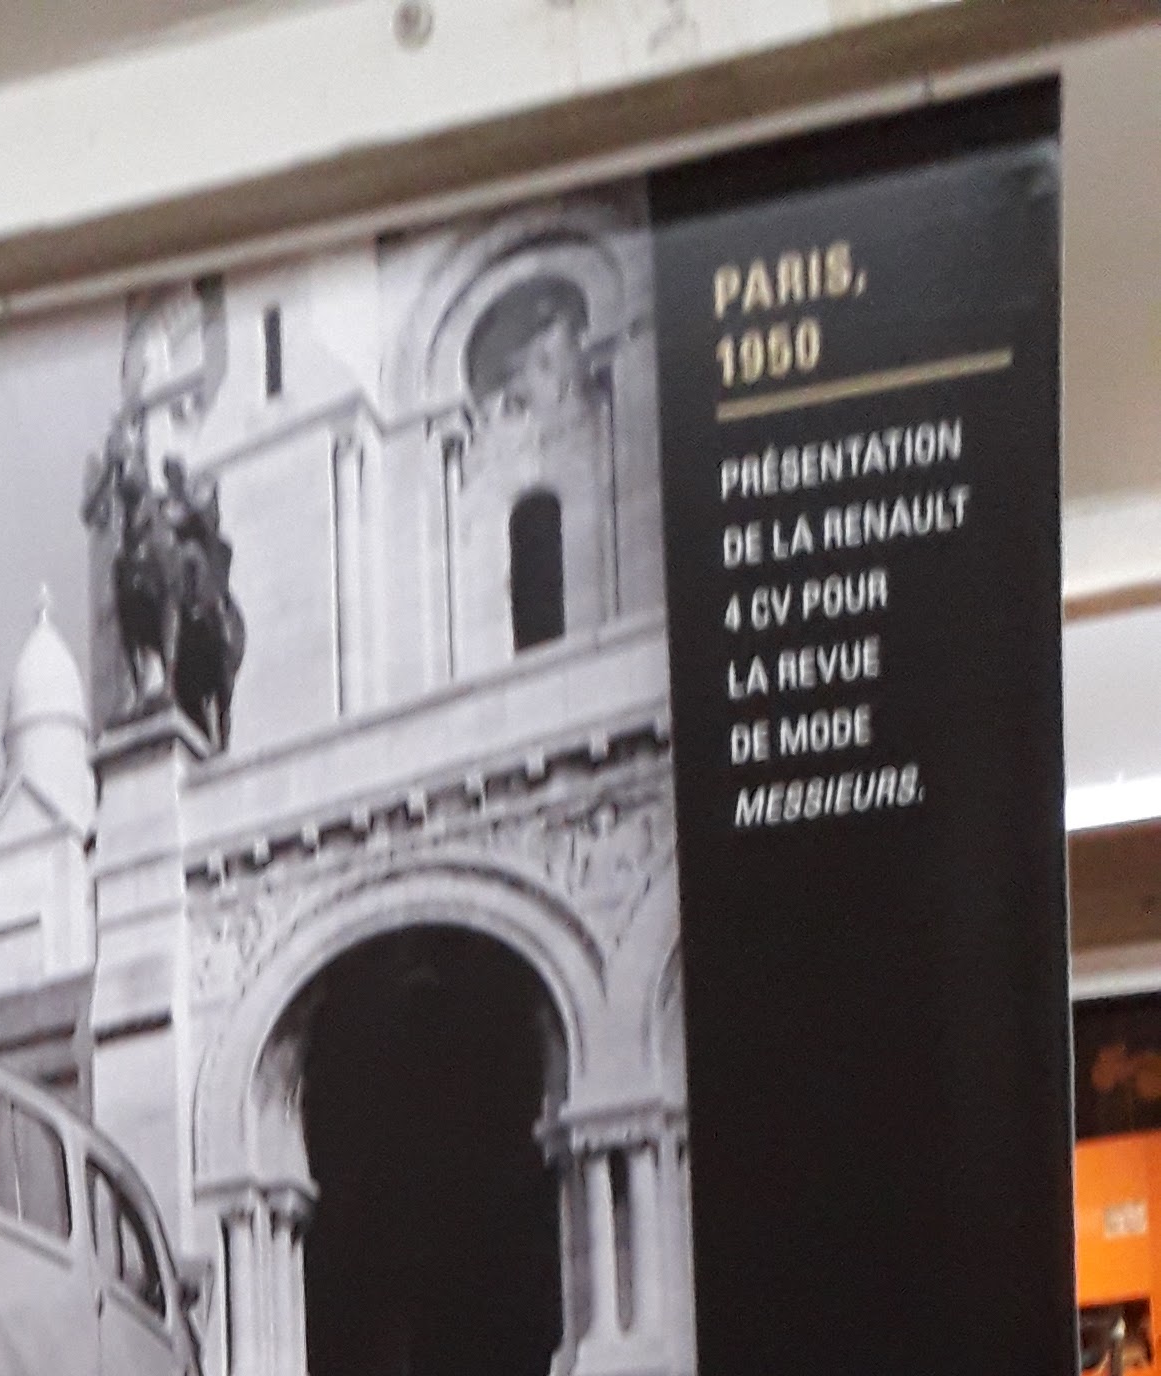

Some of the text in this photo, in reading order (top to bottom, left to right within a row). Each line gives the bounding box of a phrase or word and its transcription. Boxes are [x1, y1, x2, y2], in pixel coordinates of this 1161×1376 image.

[711, 237, 868, 322] PARIS,
[716, 315, 823, 388] 1950
[721, 418, 963, 501] PRÉSENTATION
[723, 486, 970, 569] DE LA RENAULT
[725, 568, 889, 632] 4 CV POUR
[728, 637, 880, 700] LA REVUE
[731, 706, 871, 765] DE MODE
